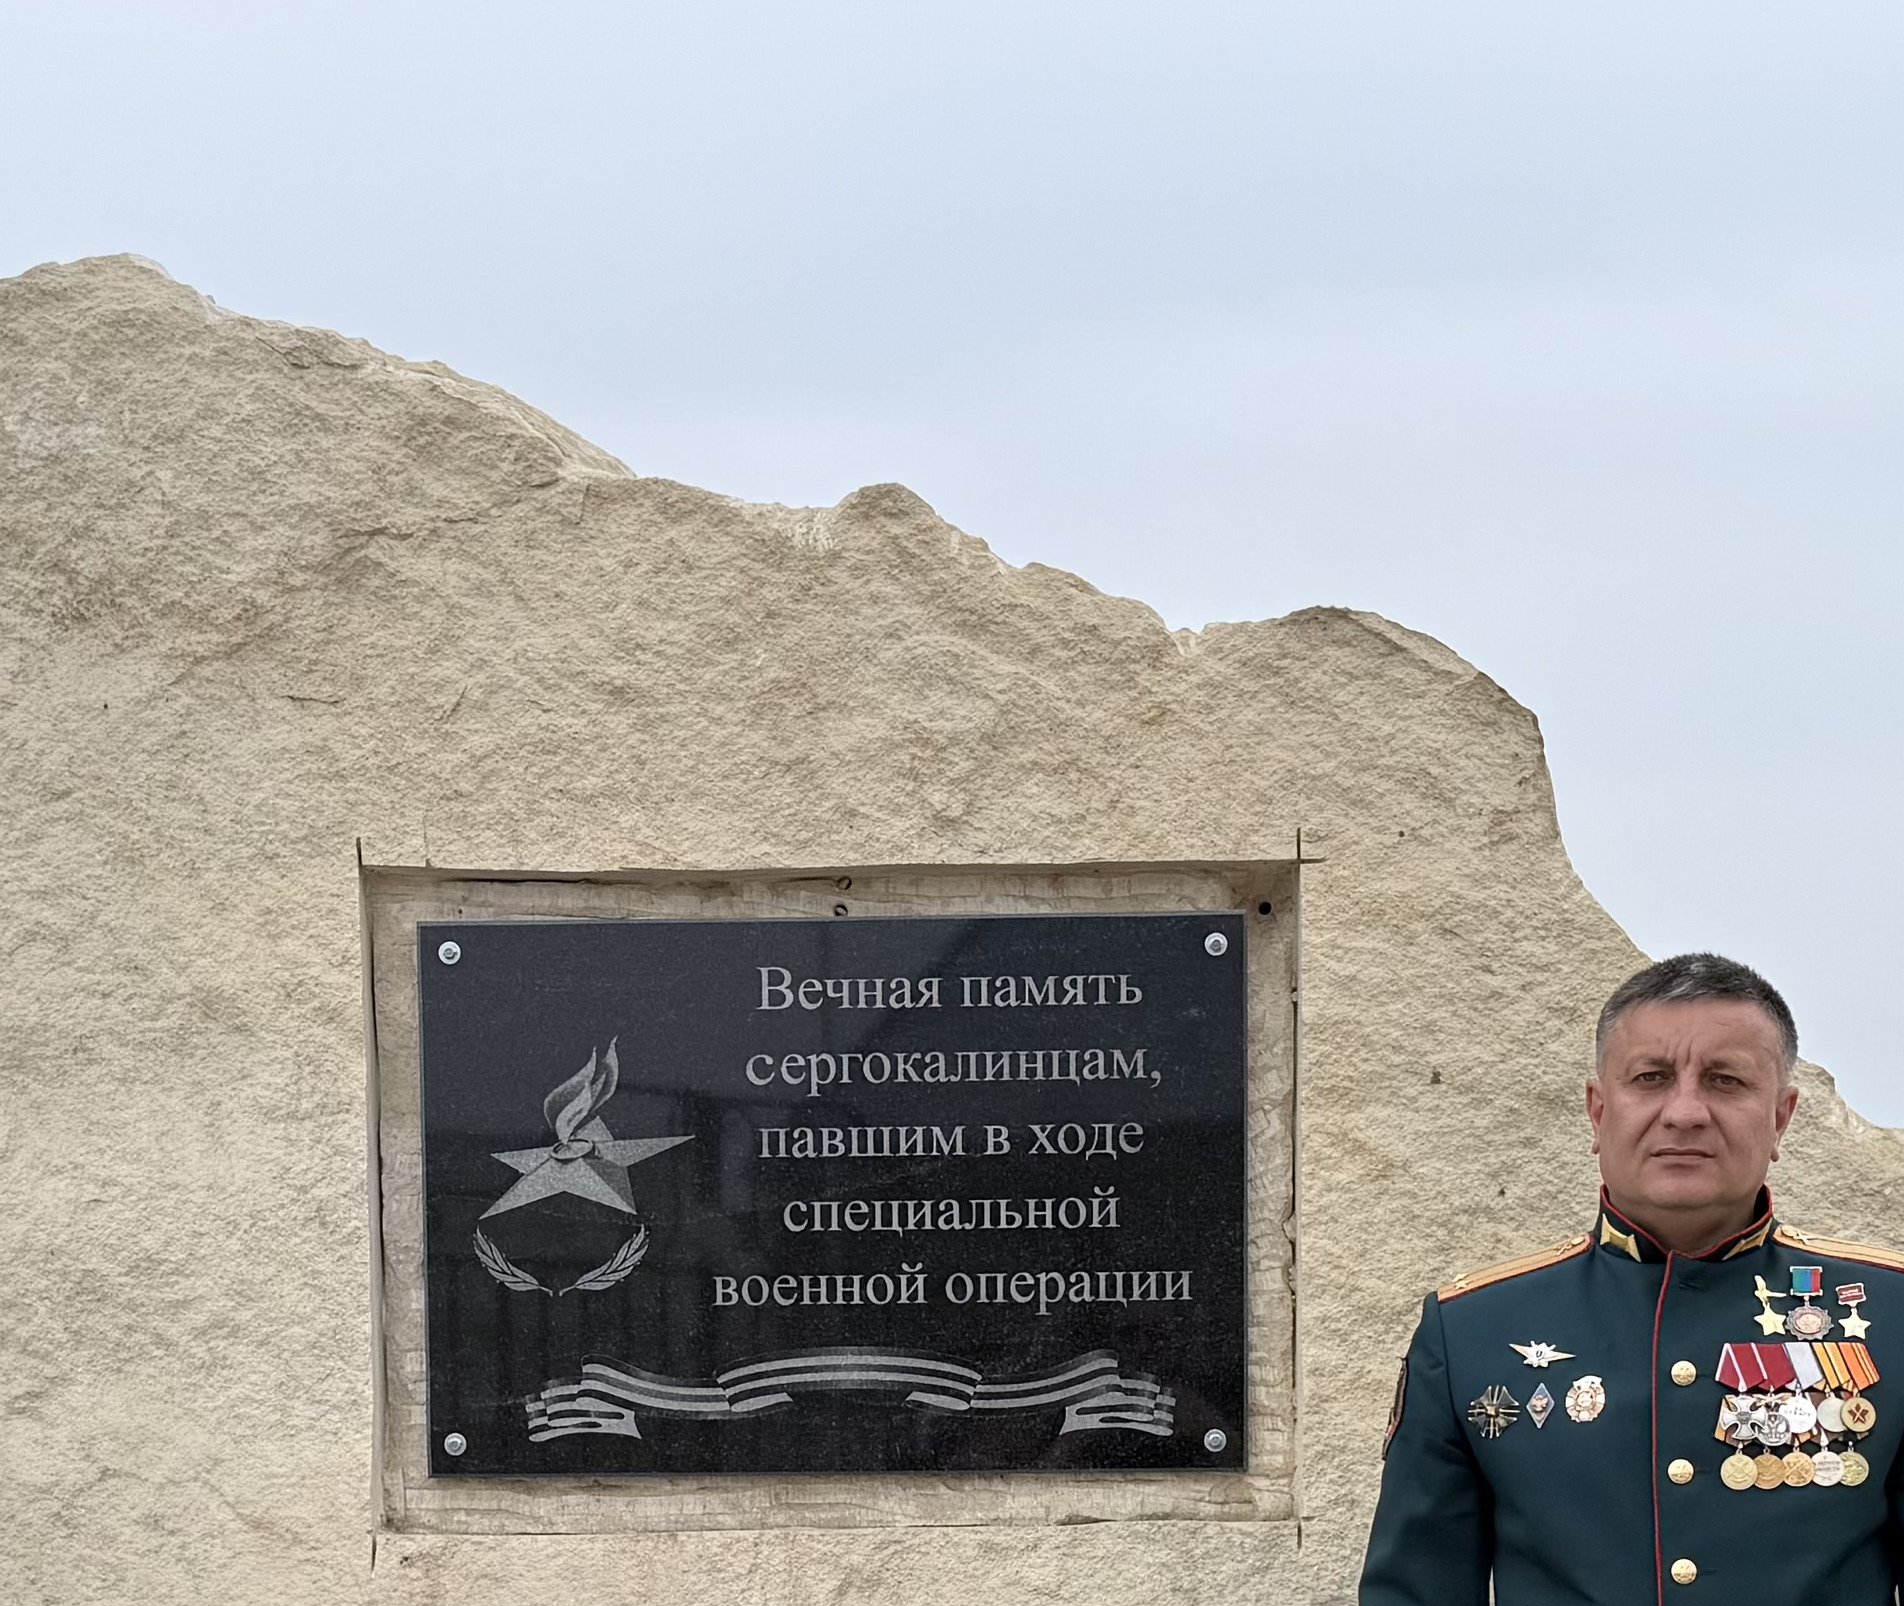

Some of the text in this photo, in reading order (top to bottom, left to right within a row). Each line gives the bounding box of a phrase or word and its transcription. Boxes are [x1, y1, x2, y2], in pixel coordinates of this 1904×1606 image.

[756, 966, 1143, 1010] Вечная память
[745, 1048, 1162, 1097] сергокалинцам,
[759, 1122, 1144, 1162] павшим в ходе
[783, 1186, 1121, 1238] специальной
[713, 1262, 1193, 1316] военной операции
